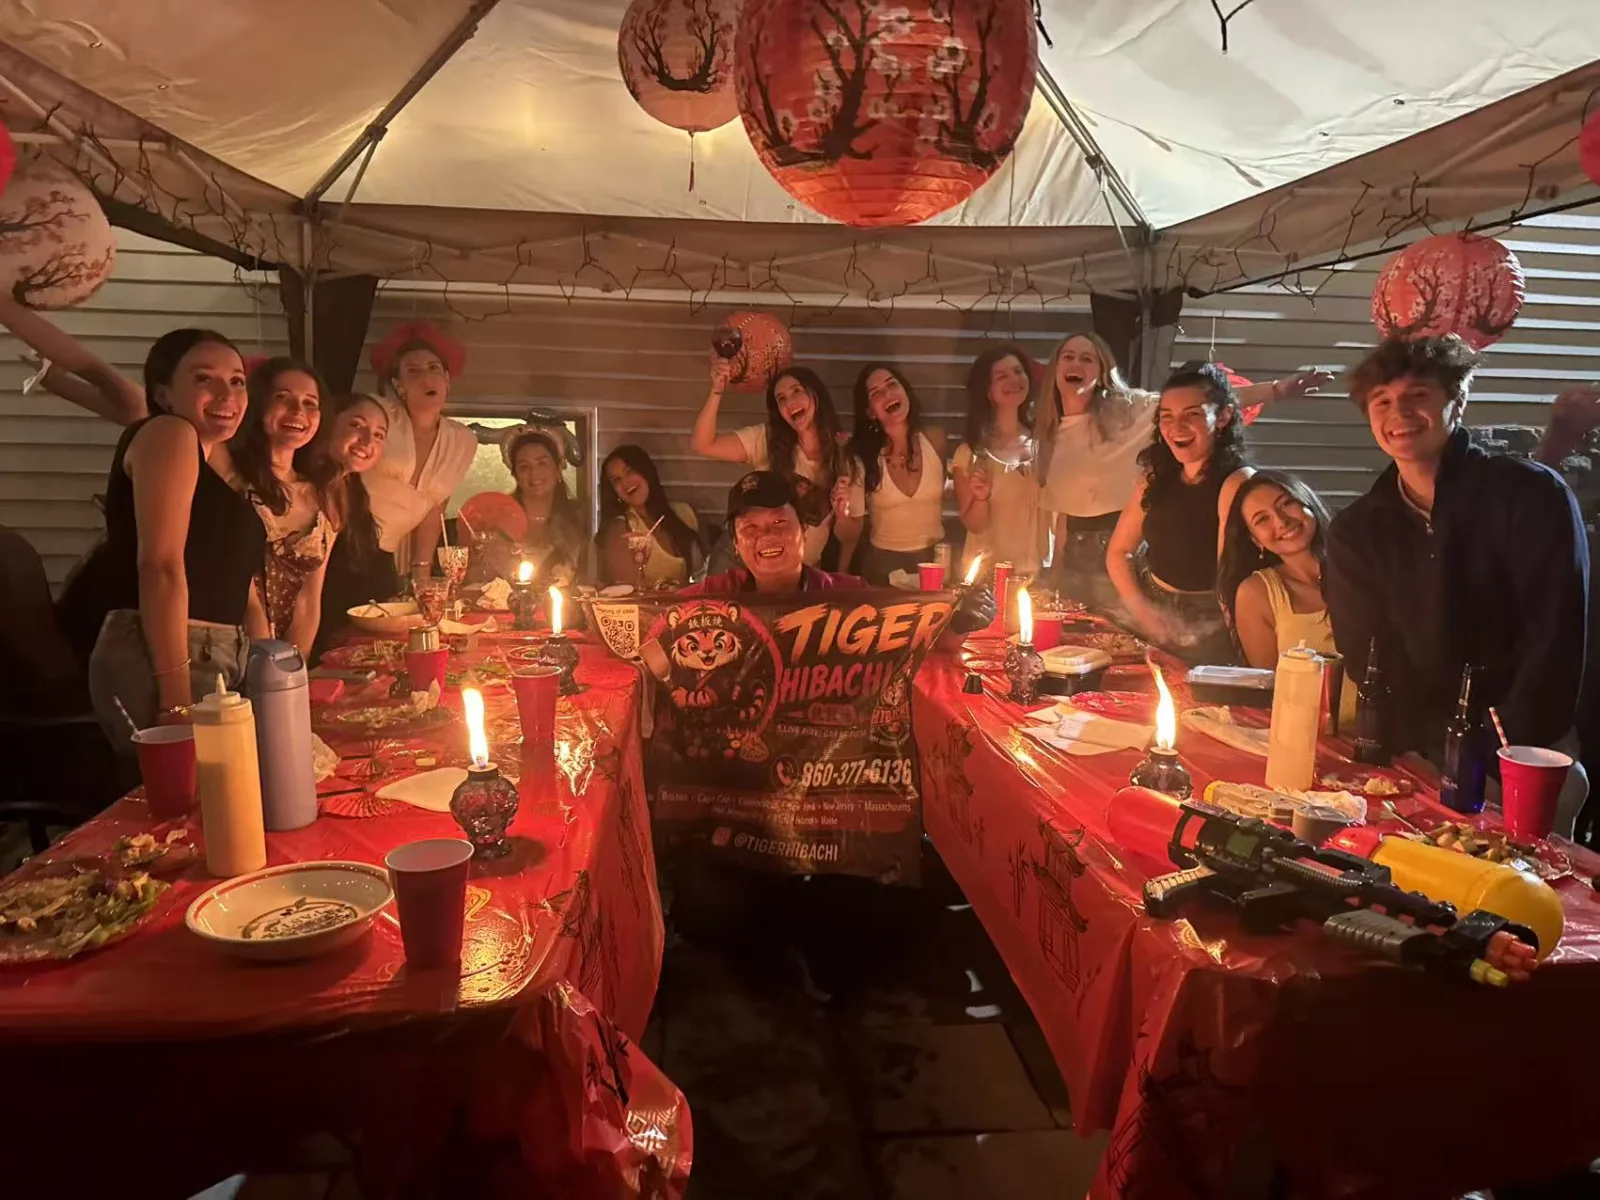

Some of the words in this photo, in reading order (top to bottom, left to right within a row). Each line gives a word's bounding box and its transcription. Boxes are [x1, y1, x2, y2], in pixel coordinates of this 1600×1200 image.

[775, 602, 951, 663] TIGER
[779, 660, 893, 704] HIBACHI
[802, 758, 912, 787] 860-377-6136
[734, 832, 838, 861] @TIGERHIBACHI
